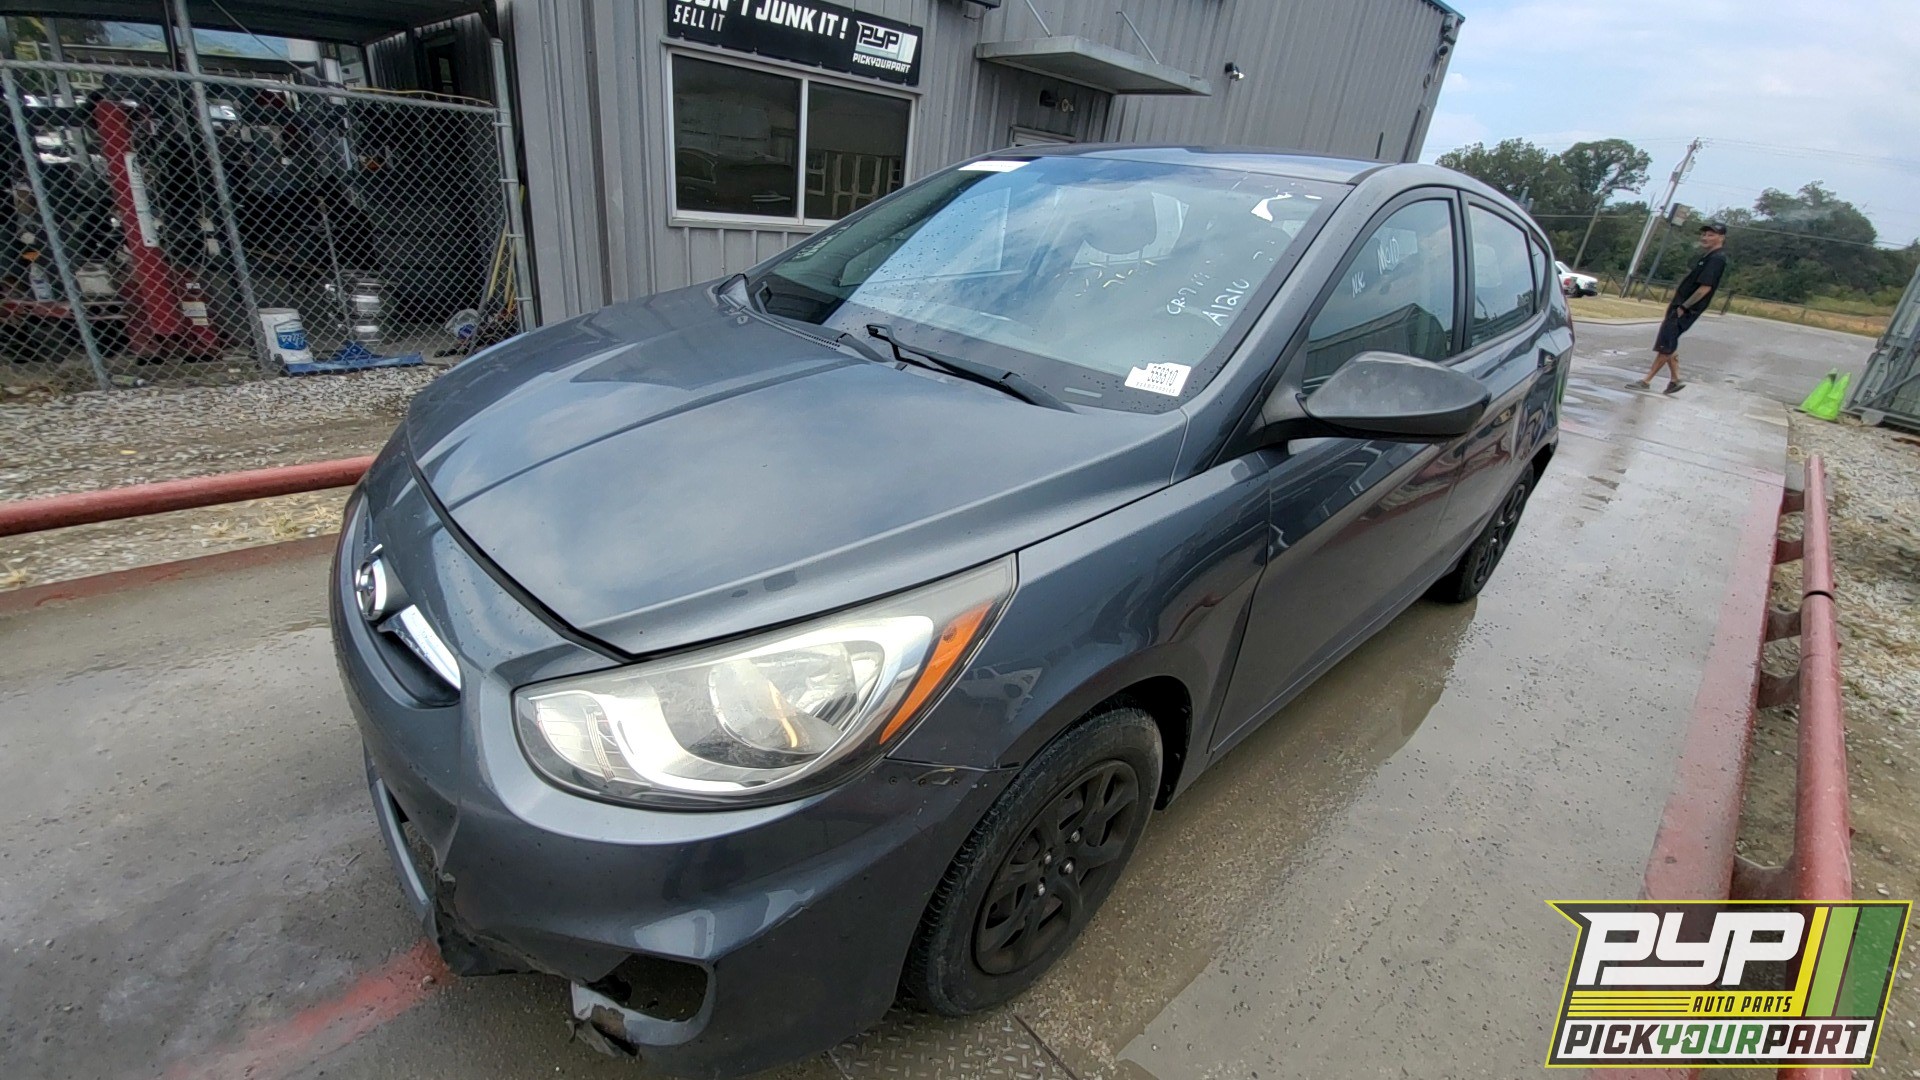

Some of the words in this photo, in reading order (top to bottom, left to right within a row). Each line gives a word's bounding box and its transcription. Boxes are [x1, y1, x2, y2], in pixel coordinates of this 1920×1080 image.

[672, 4, 705, 29] SELL
[710, 12, 726, 32] IT
[755, 0, 818, 32] JUNK
[858, 24, 900, 50] PYP
[852, 52, 911, 74] PICKYOURPART
